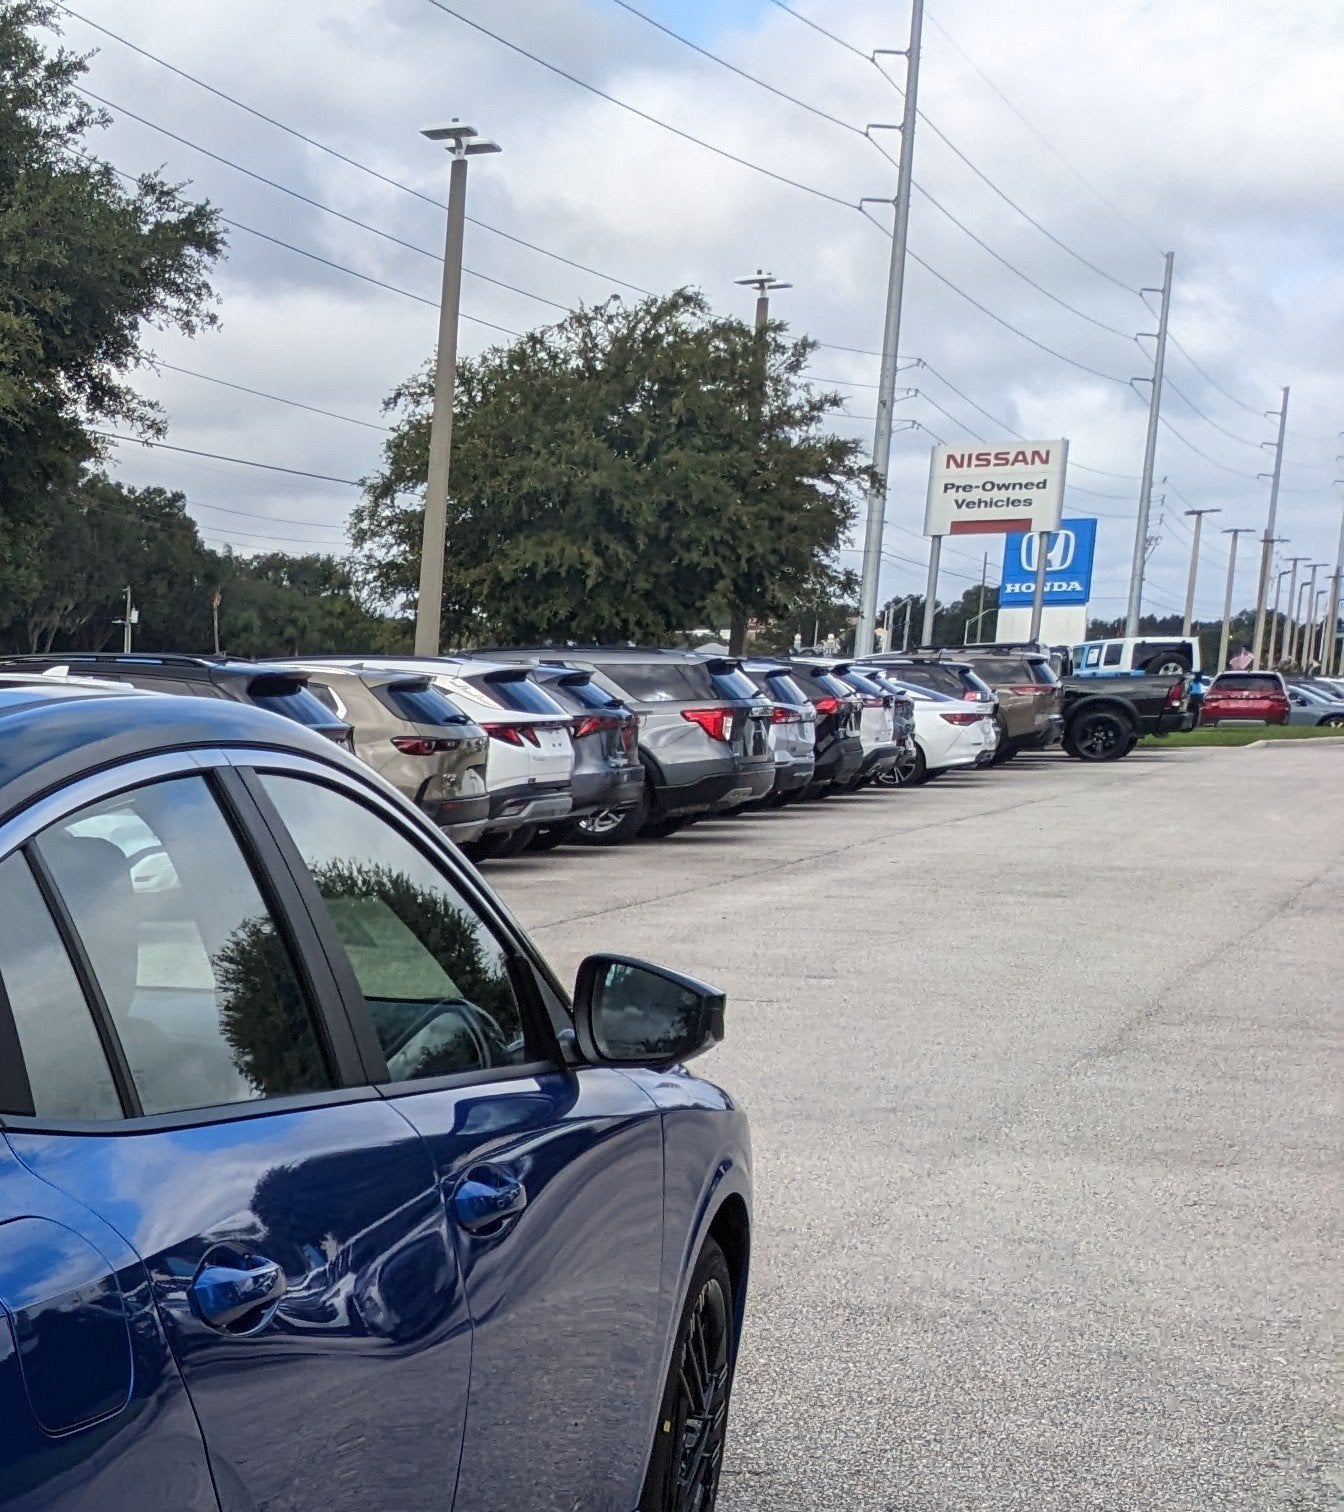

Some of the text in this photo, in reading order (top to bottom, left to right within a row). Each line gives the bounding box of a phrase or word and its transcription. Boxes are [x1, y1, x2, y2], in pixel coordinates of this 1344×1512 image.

[945, 449, 1050, 469] NISSAN
[943, 478, 1048, 494] Pre-Owned
[953, 496, 1034, 510] Vehicles
